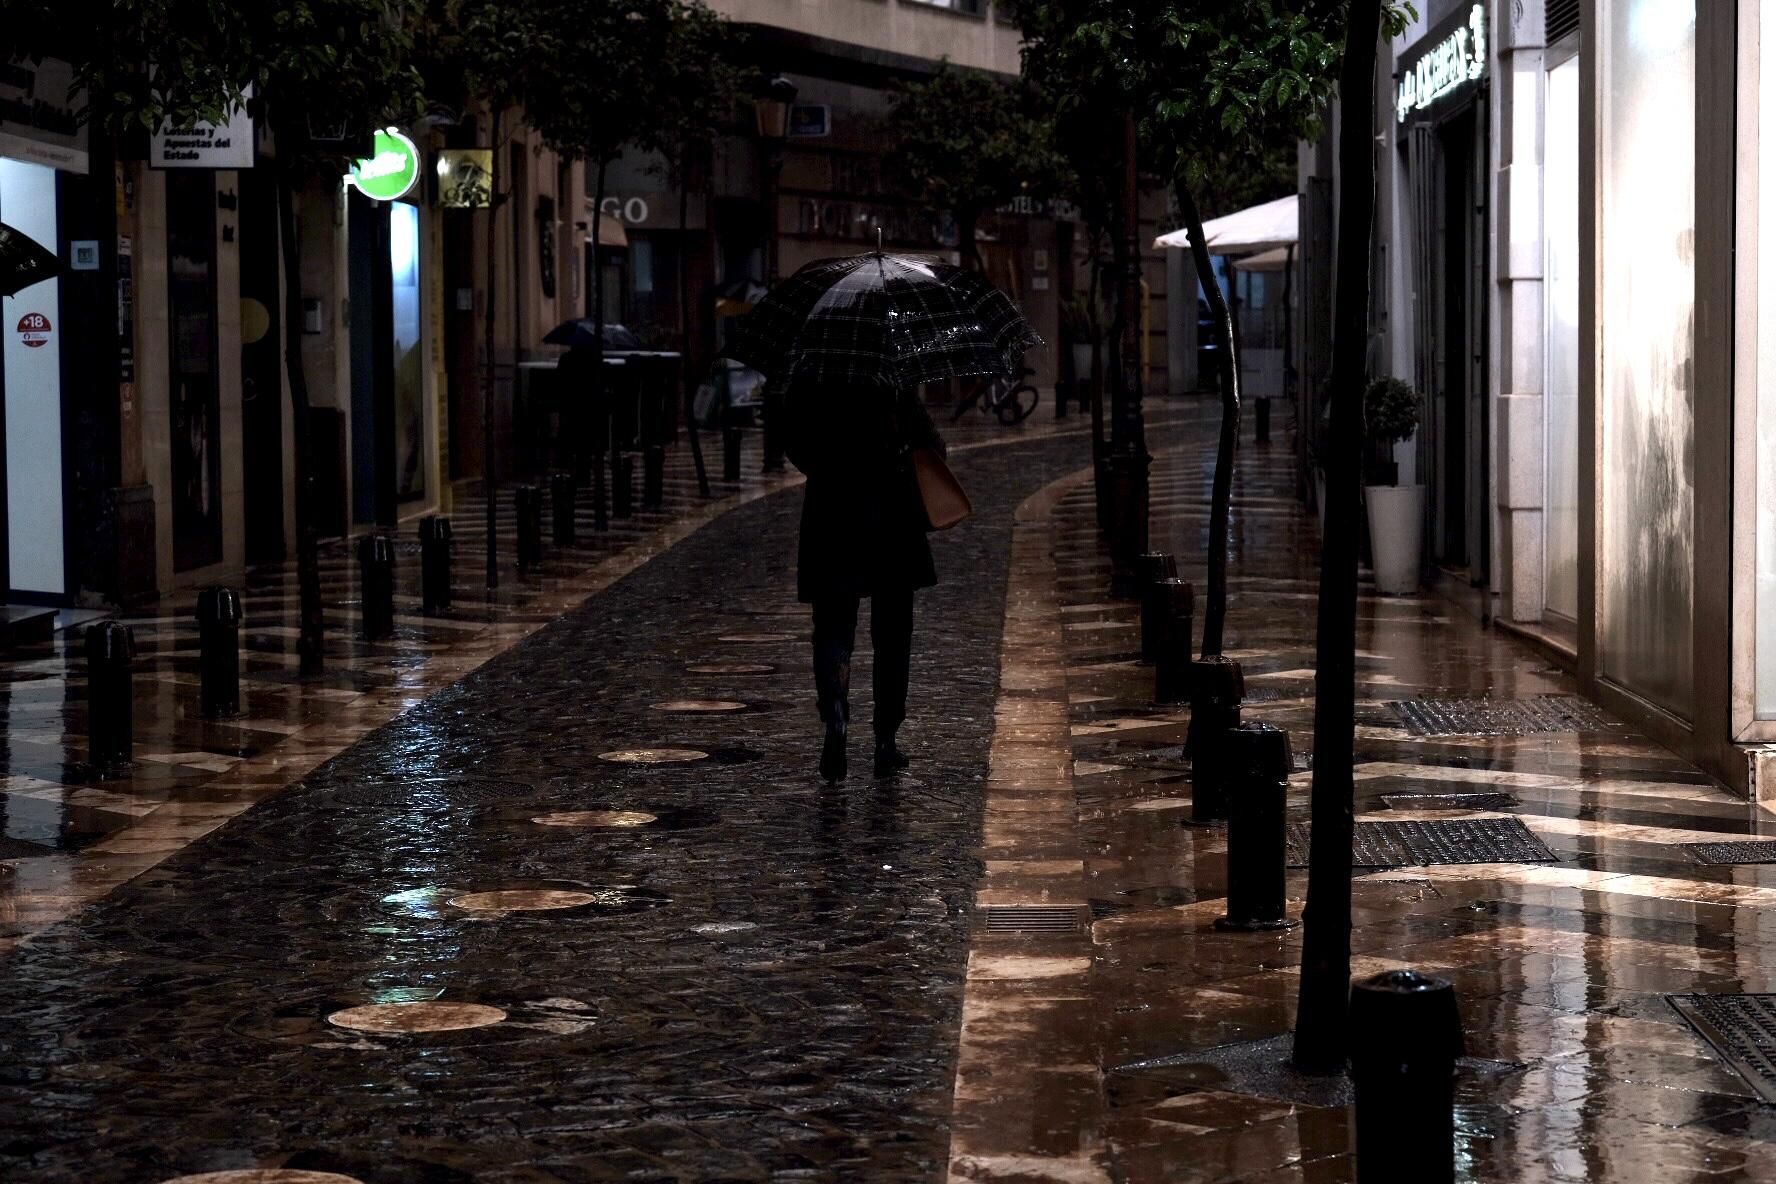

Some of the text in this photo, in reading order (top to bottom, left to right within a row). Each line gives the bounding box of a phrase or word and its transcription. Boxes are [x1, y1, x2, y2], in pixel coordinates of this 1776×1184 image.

[208, 128, 215, 138] y
[164, 138, 230, 149] Apuestas del
[164, 150, 199, 160] Estado
[24, 316, 44, 328] +18
